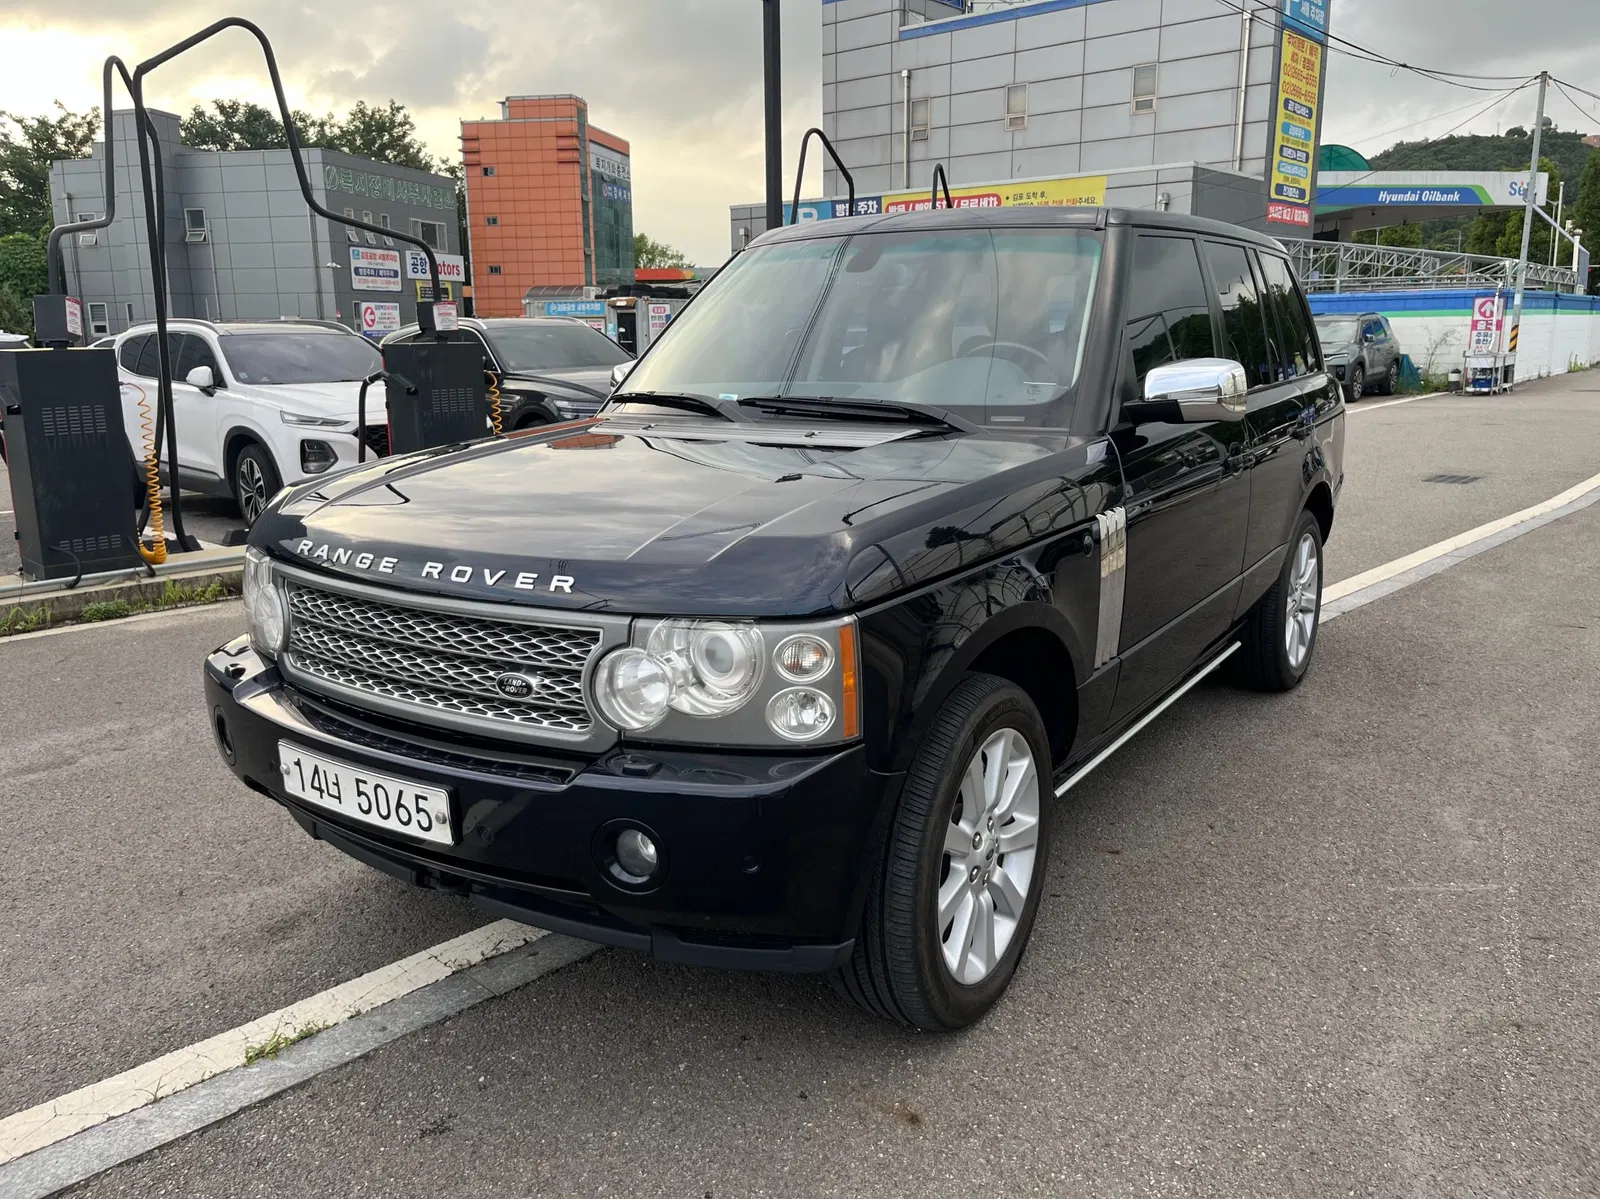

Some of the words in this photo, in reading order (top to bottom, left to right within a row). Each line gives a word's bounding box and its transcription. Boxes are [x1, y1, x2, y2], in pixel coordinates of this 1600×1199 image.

[1012, 192, 1024, 202] 김포
[1025, 191, 1038, 200] 도착
[1378, 190, 1419, 204] Hyundai
[1422, 190, 1460, 202] Oilbank
[857, 200, 878, 214] 주차
[411, 256, 427, 274] 공항
[430, 260, 460, 276] otors
[297, 540, 398, 574] RANGE
[422, 562, 575, 593] ROVER
[504, 678, 522, 686] LAND
[505, 686, 528, 694] ROVER
[294, 758, 342, 804] 14너
[355, 777, 432, 832] 5065
